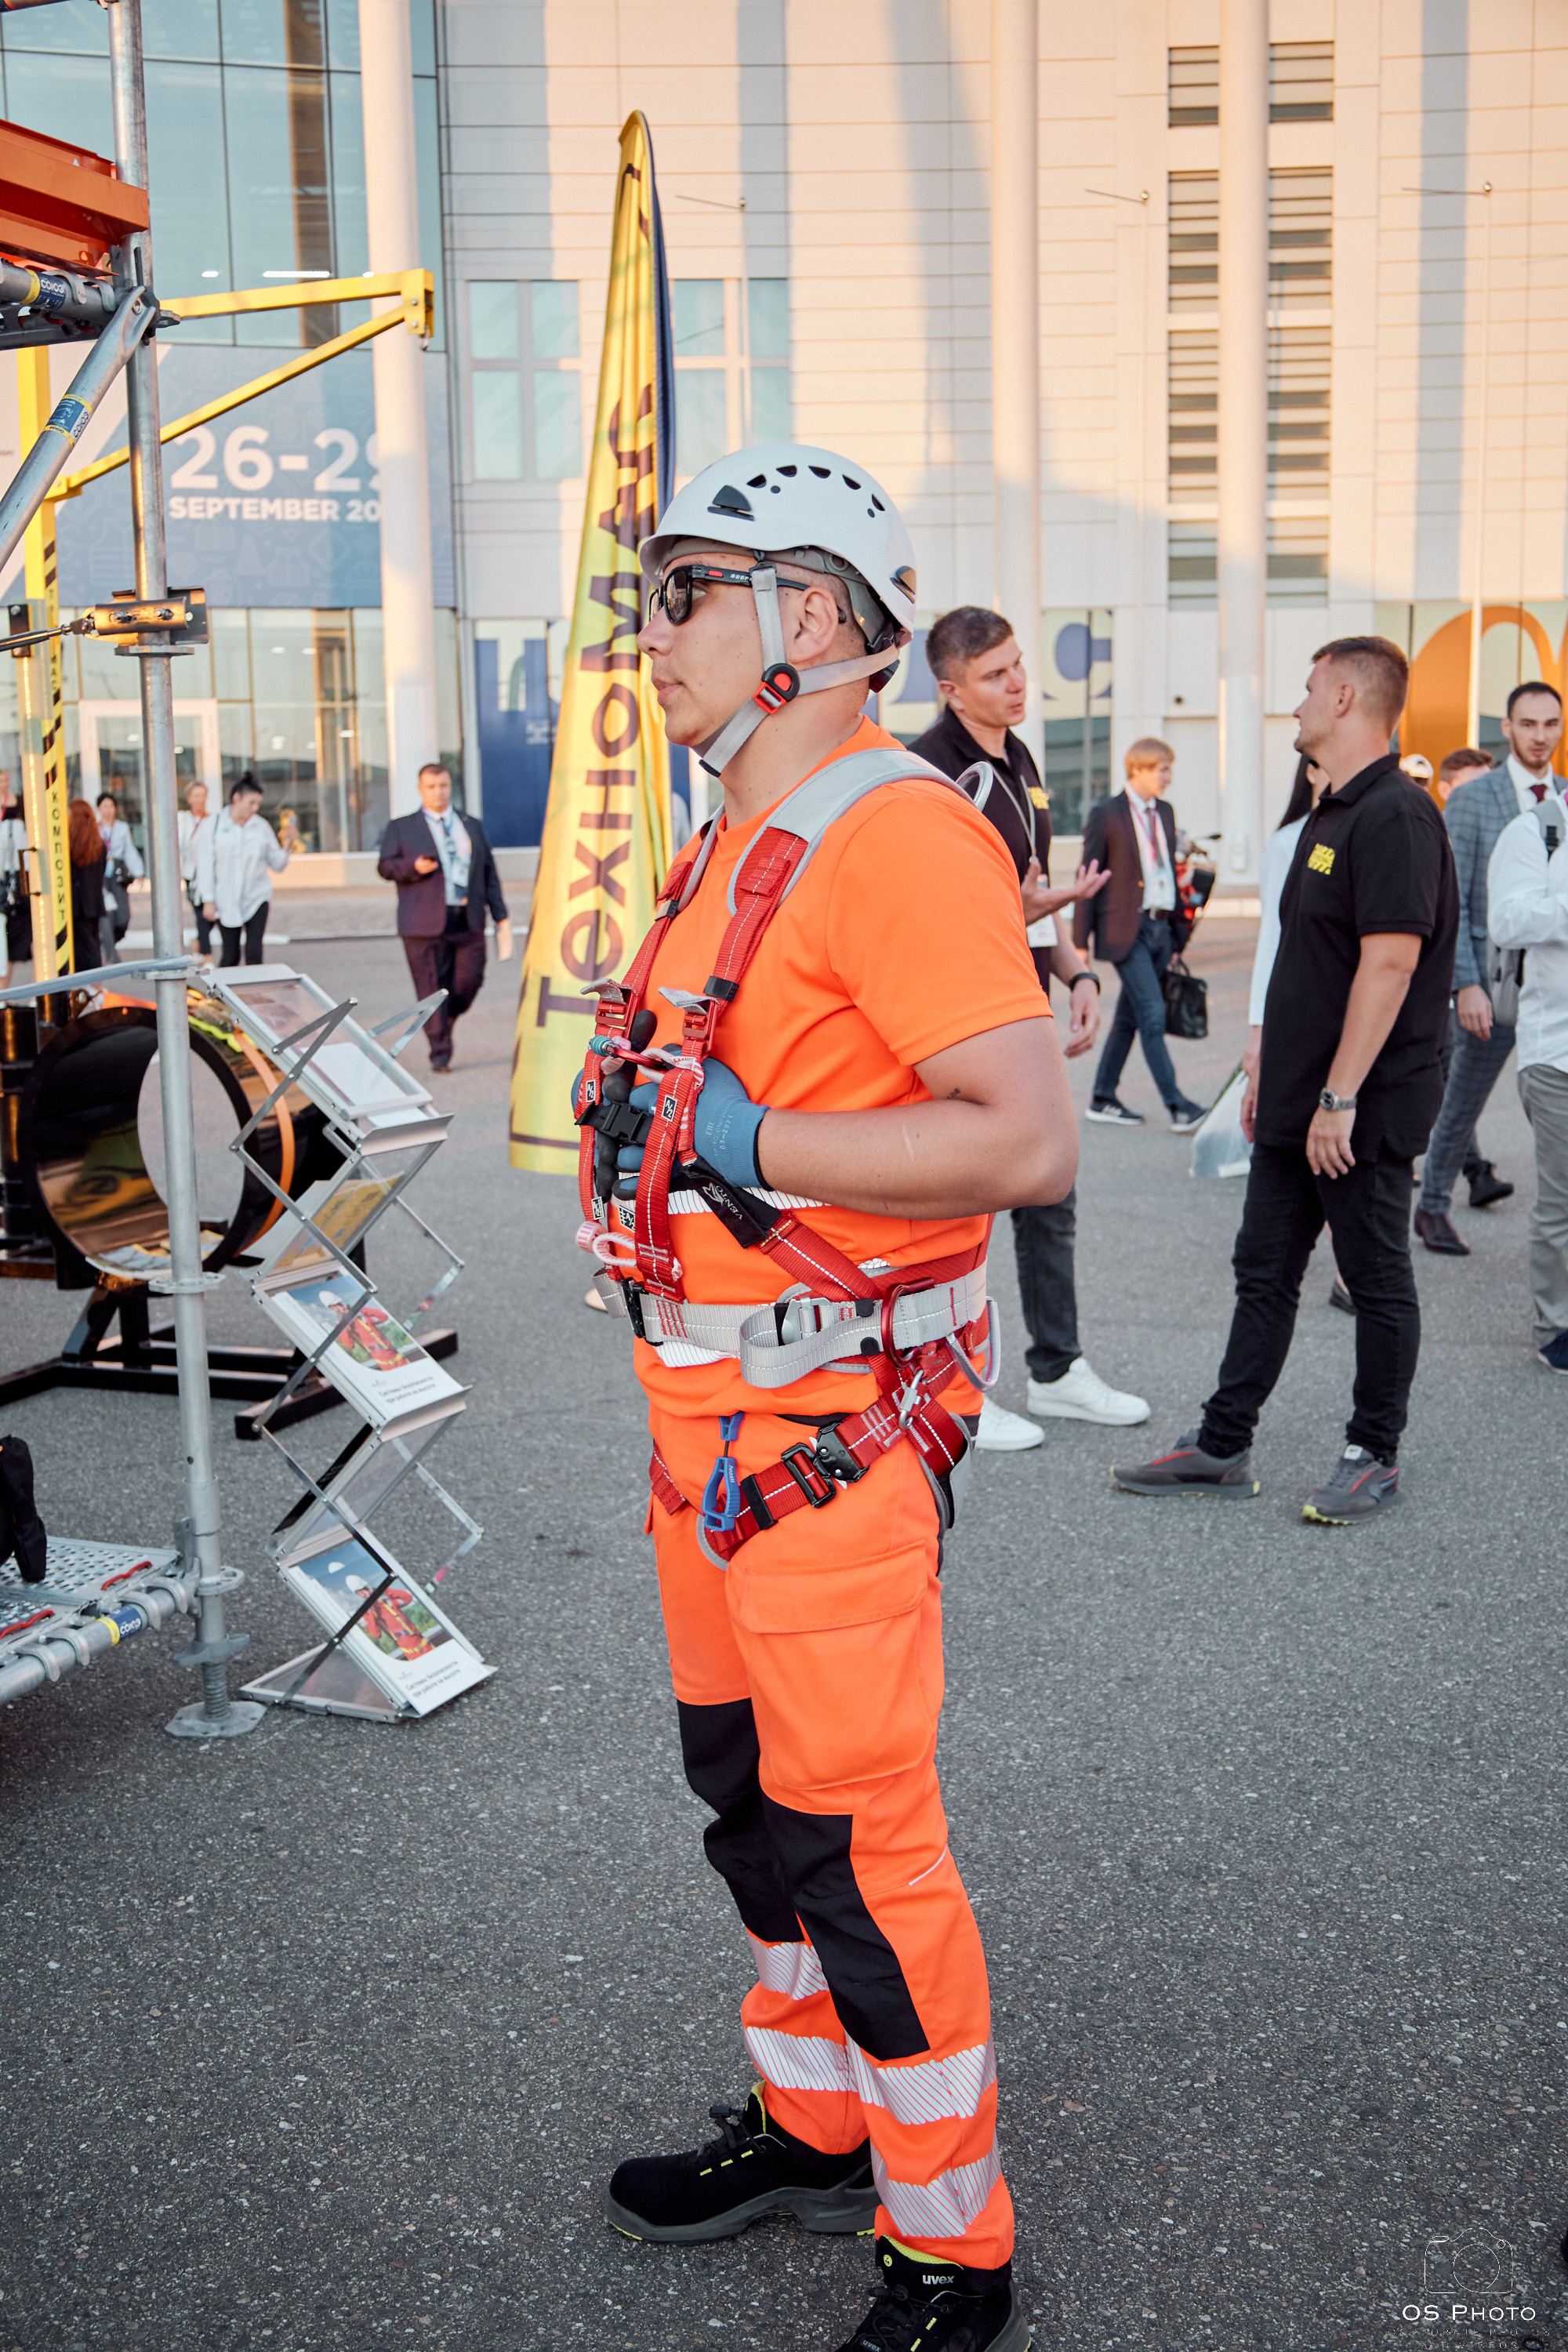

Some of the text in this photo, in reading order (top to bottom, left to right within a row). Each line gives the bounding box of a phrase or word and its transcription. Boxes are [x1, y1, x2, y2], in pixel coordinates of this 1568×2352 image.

[167, 495, 380, 522] SEPTEMBER 20
[52, 792, 66, 920] КОМПОЗИТ
[665, 1099, 673, 1118] A/2
[716, 1185, 742, 1220] VENTO
[922, 2274, 955, 2285] uvex
[862, 2339, 881, 2352] uvex
